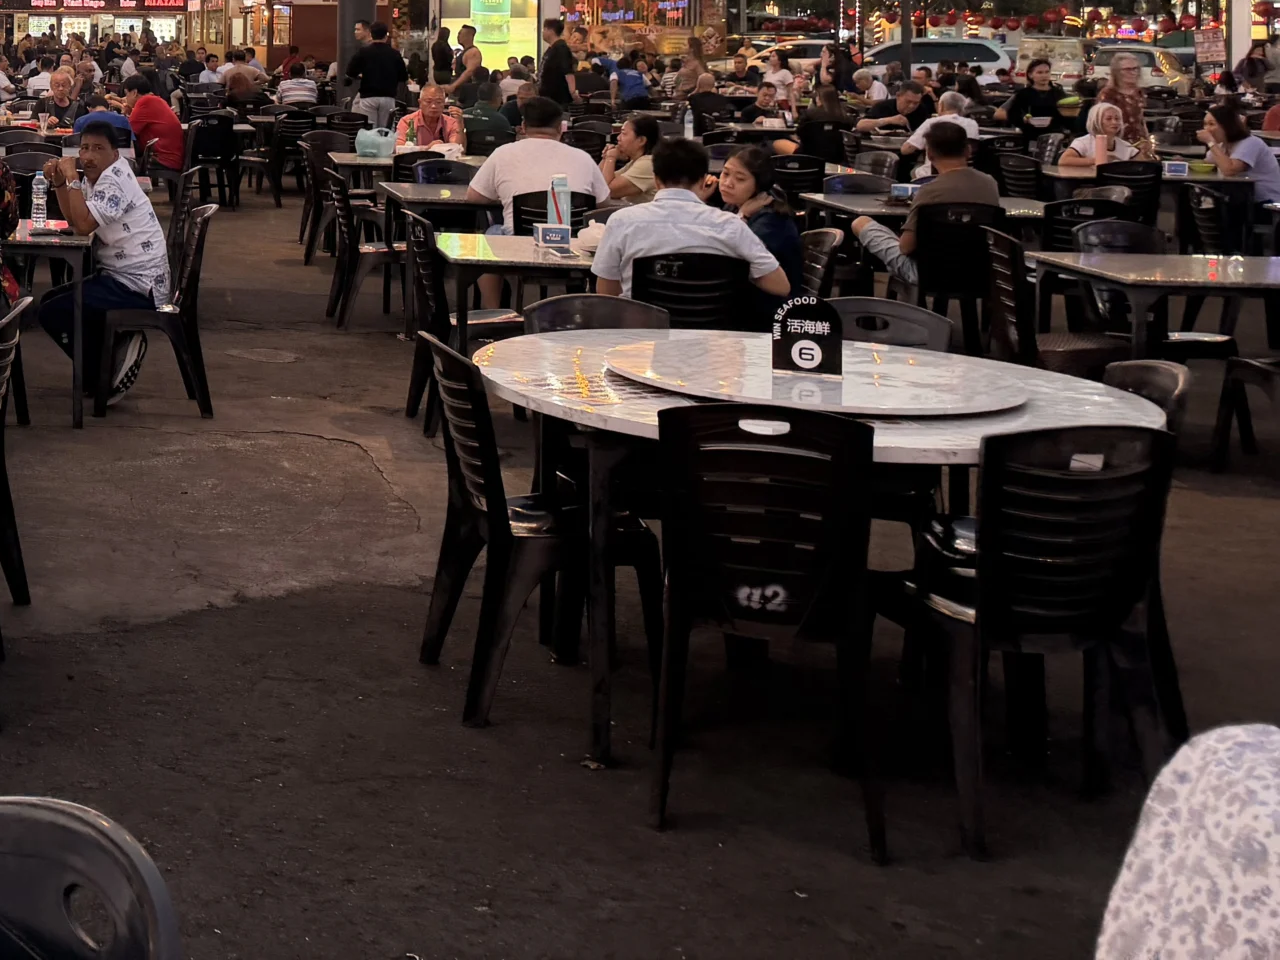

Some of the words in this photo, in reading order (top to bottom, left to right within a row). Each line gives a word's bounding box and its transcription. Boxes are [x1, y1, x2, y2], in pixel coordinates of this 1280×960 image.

[773, 296, 818, 322] SEAFOOD
[772, 322, 782, 341] WIN
[798, 346, 815, 362] 6
